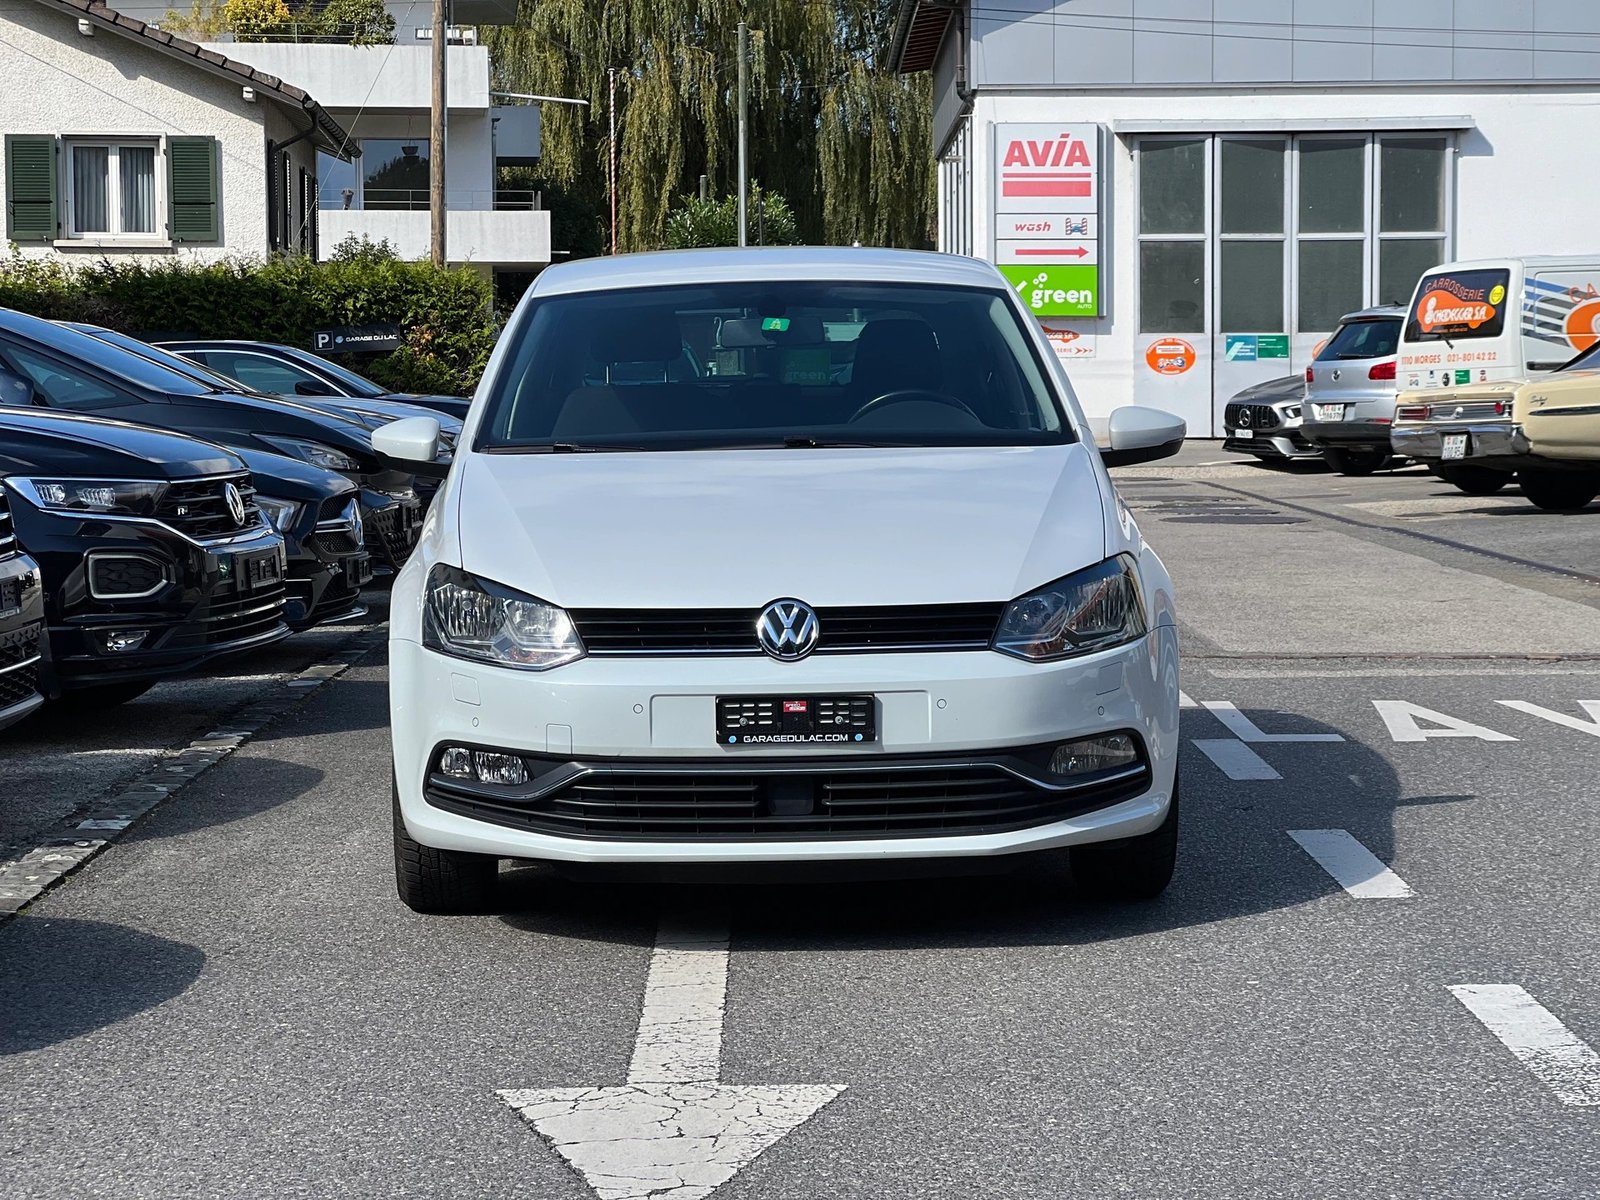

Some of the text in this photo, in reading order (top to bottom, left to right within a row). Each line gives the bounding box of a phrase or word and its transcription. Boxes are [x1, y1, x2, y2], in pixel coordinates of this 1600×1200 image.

[1015, 221, 1051, 232] wash
[1425, 278, 1485, 300] CARROSSERIE
[1031, 289, 1092, 308] green
[317, 333, 330, 348] P
[743, 733, 849, 743] GARAGEDULAC.COM
